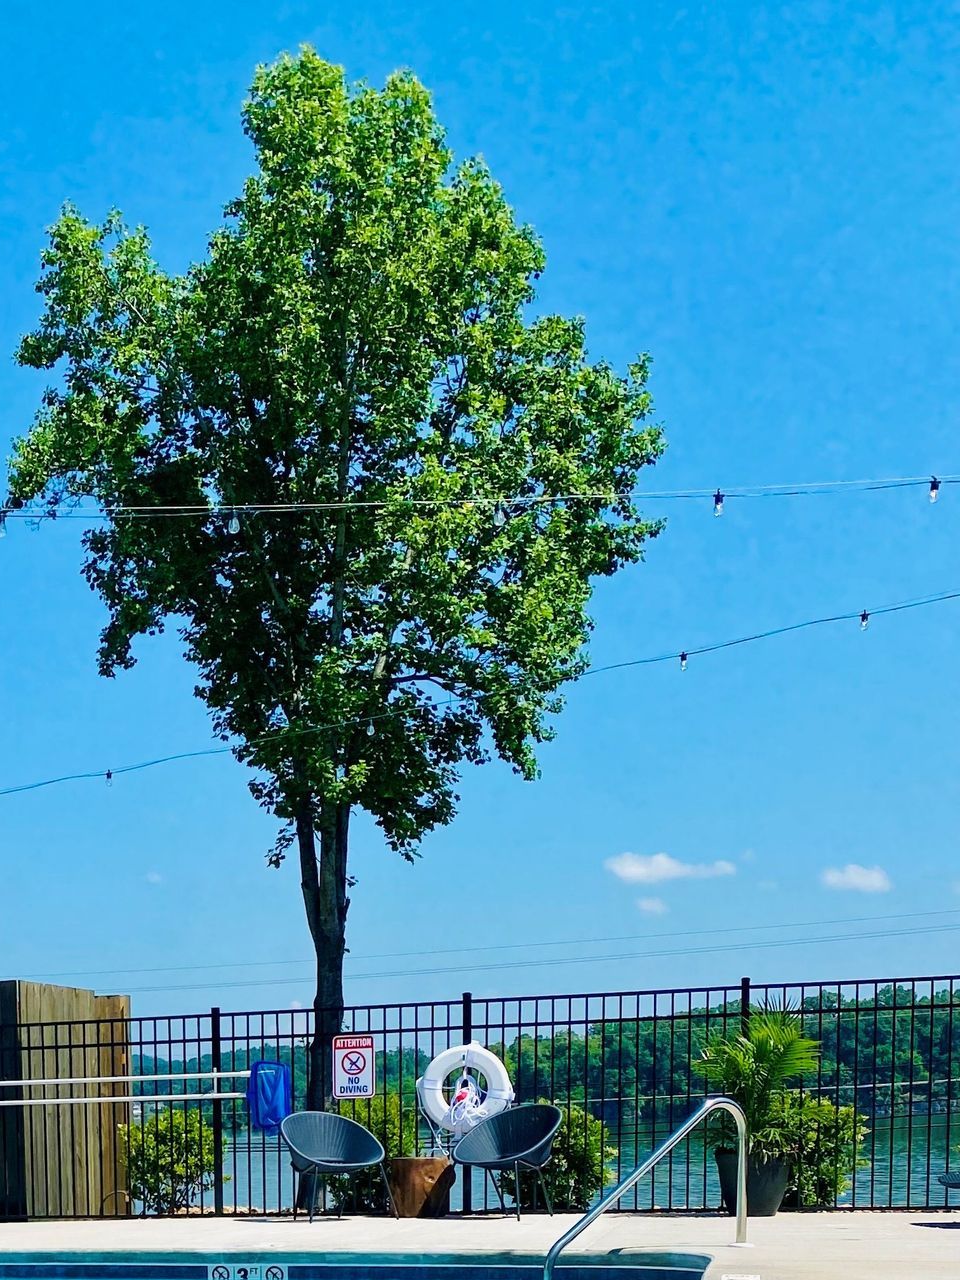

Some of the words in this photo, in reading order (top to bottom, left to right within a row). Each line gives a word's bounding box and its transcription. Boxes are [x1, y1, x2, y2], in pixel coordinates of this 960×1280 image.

[336, 1038, 372, 1047] ATTENTION
[348, 1077, 360, 1085] NO
[340, 1085, 368, 1093] DIVING
[237, 1268, 248, 1280] 3
